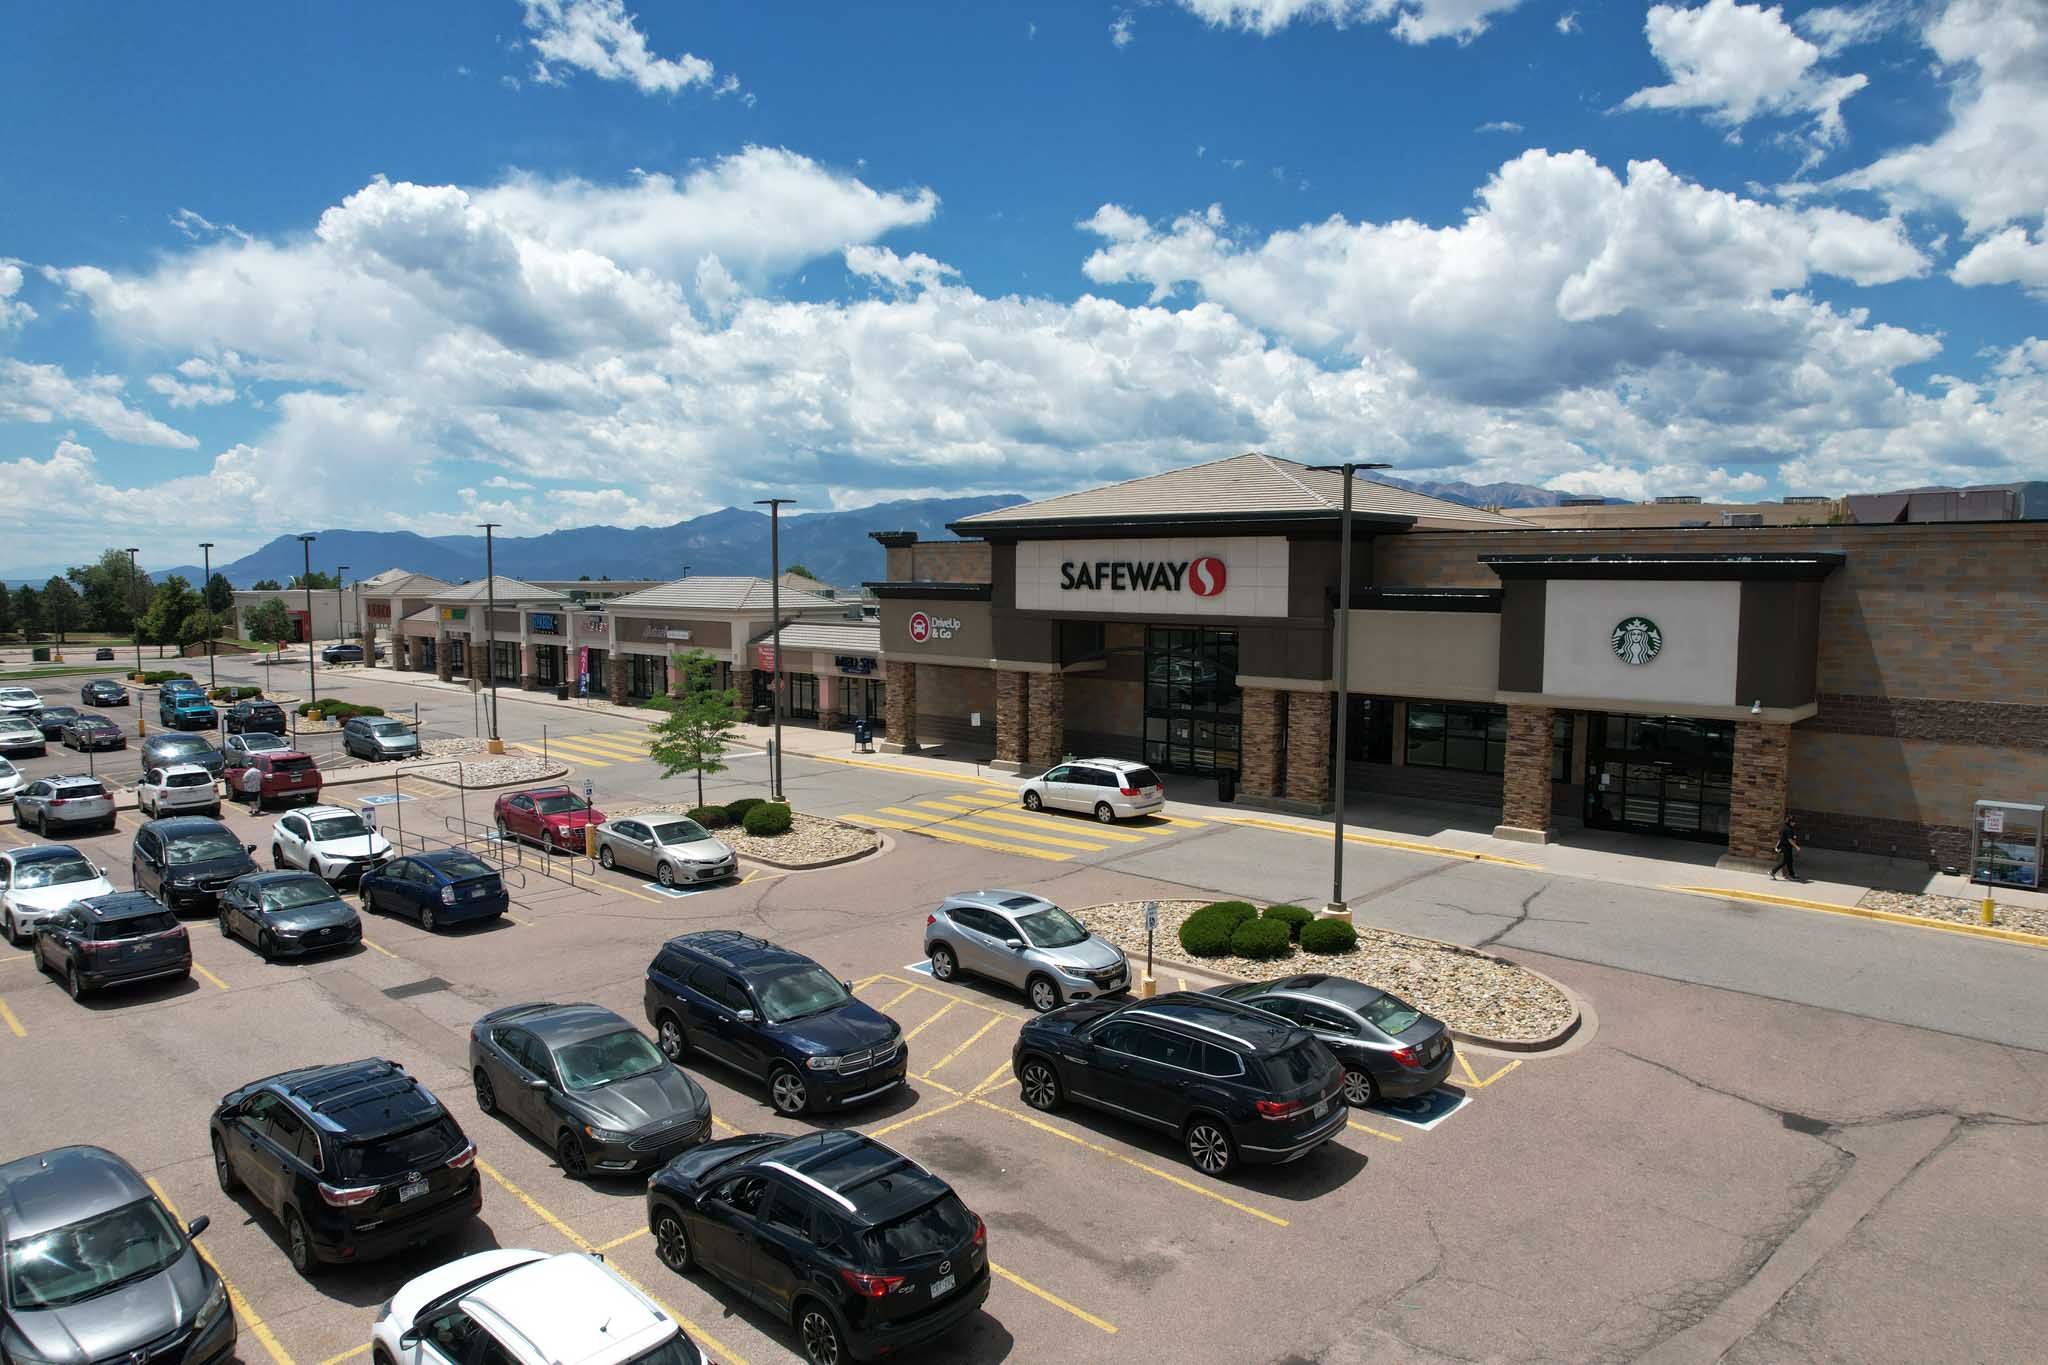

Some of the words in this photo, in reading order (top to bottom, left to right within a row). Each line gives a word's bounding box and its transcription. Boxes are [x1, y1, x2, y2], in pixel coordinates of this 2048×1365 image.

[1061, 562, 1188, 591] SAFEWAY
[932, 628, 938, 639] &
[940, 629, 952, 639] Go
